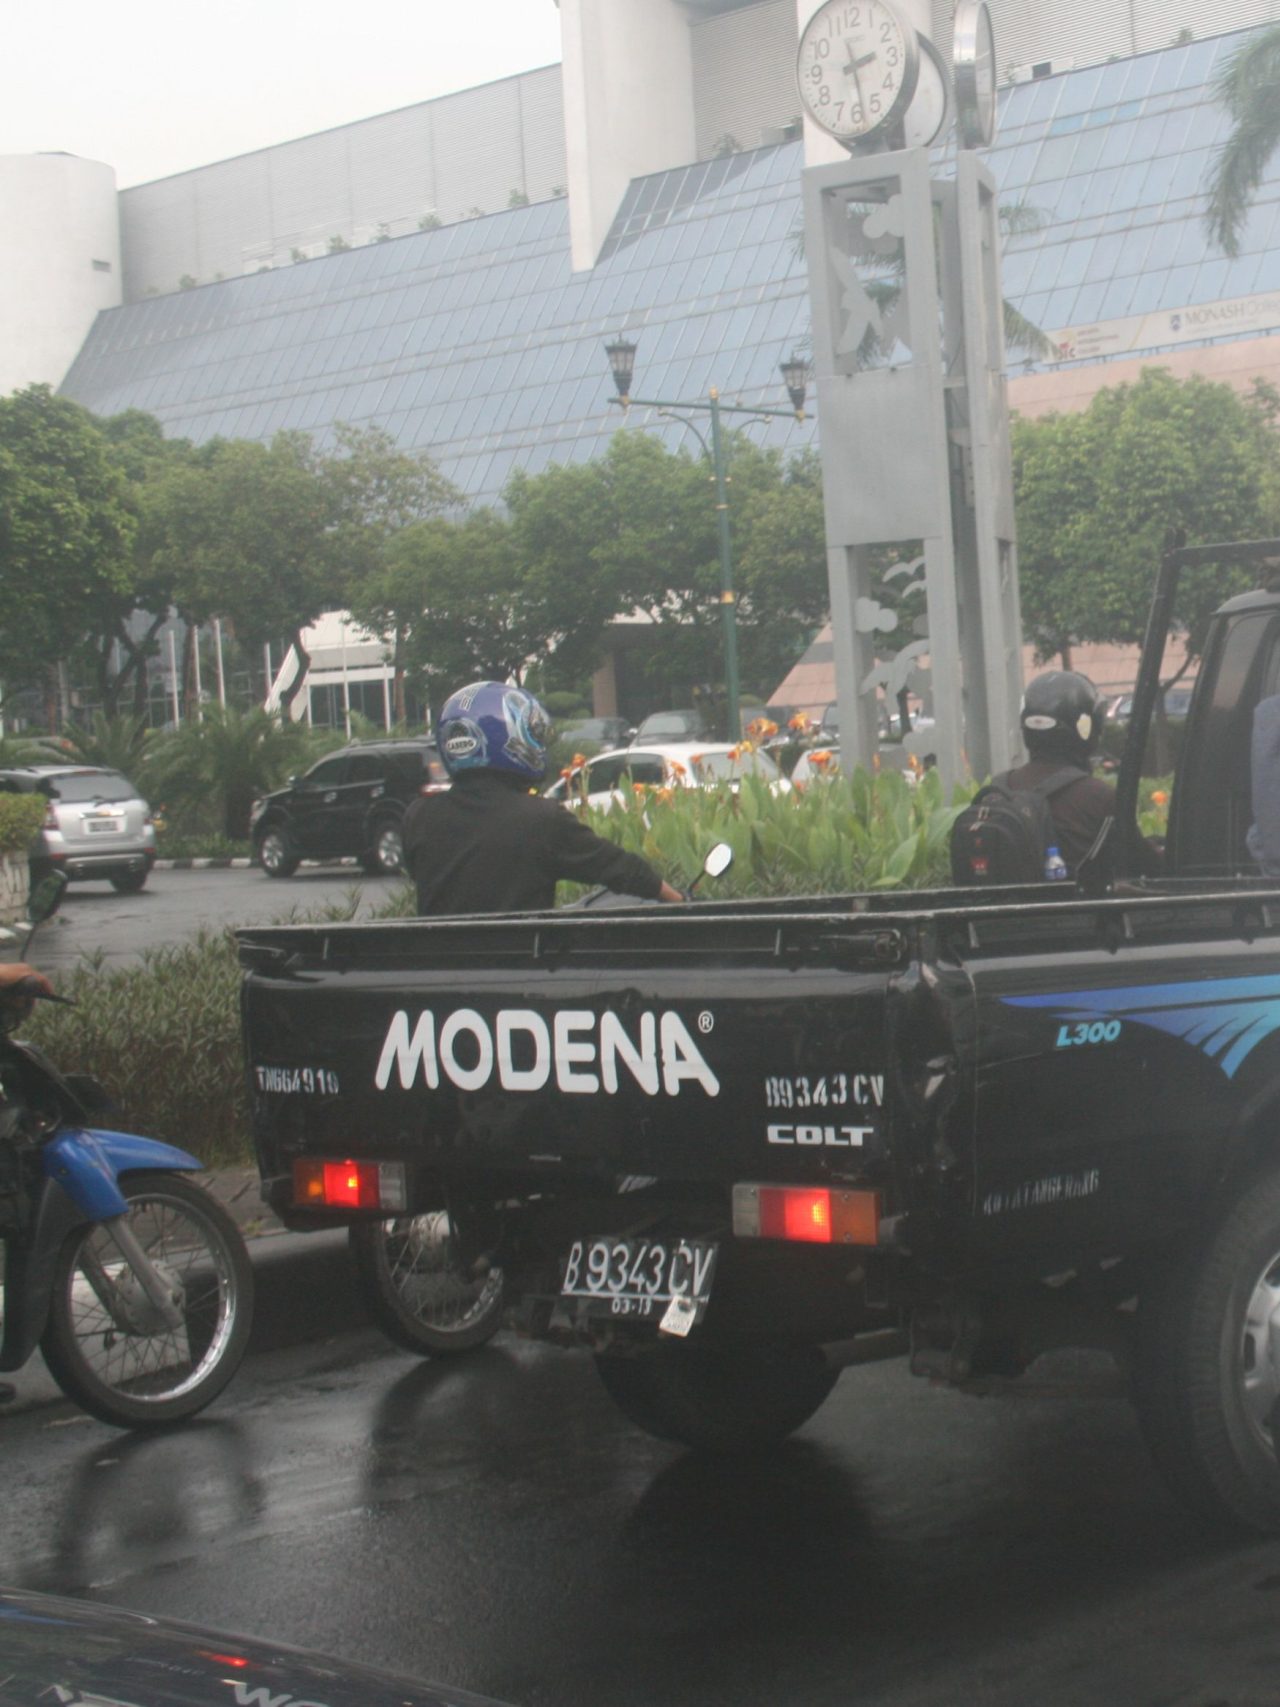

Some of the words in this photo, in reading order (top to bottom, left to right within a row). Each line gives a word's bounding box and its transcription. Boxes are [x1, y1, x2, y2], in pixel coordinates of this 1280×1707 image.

[828, 13, 841, 37] 11
[844, 7, 860, 28] 12
[880, 22, 891, 43] 2
[812, 38, 830, 60] 10
[886, 46, 898, 67] 3
[811, 65, 822, 85] 9
[882, 72, 894, 92] 4
[818, 85, 831, 106] 8
[869, 93, 881, 114] 5
[833, 101, 845, 122] 7
[851, 103, 864, 124] 6
[1185, 302, 1245, 324] MONASH
[1056, 1020, 1121, 1046] L300
[375, 1008, 720, 1096] MODENA
[767, 1124, 874, 1146] COLT
[563, 1241, 582, 1291] B
[586, 1242, 665, 1294] 9343
[668, 1243, 713, 1296] CV
